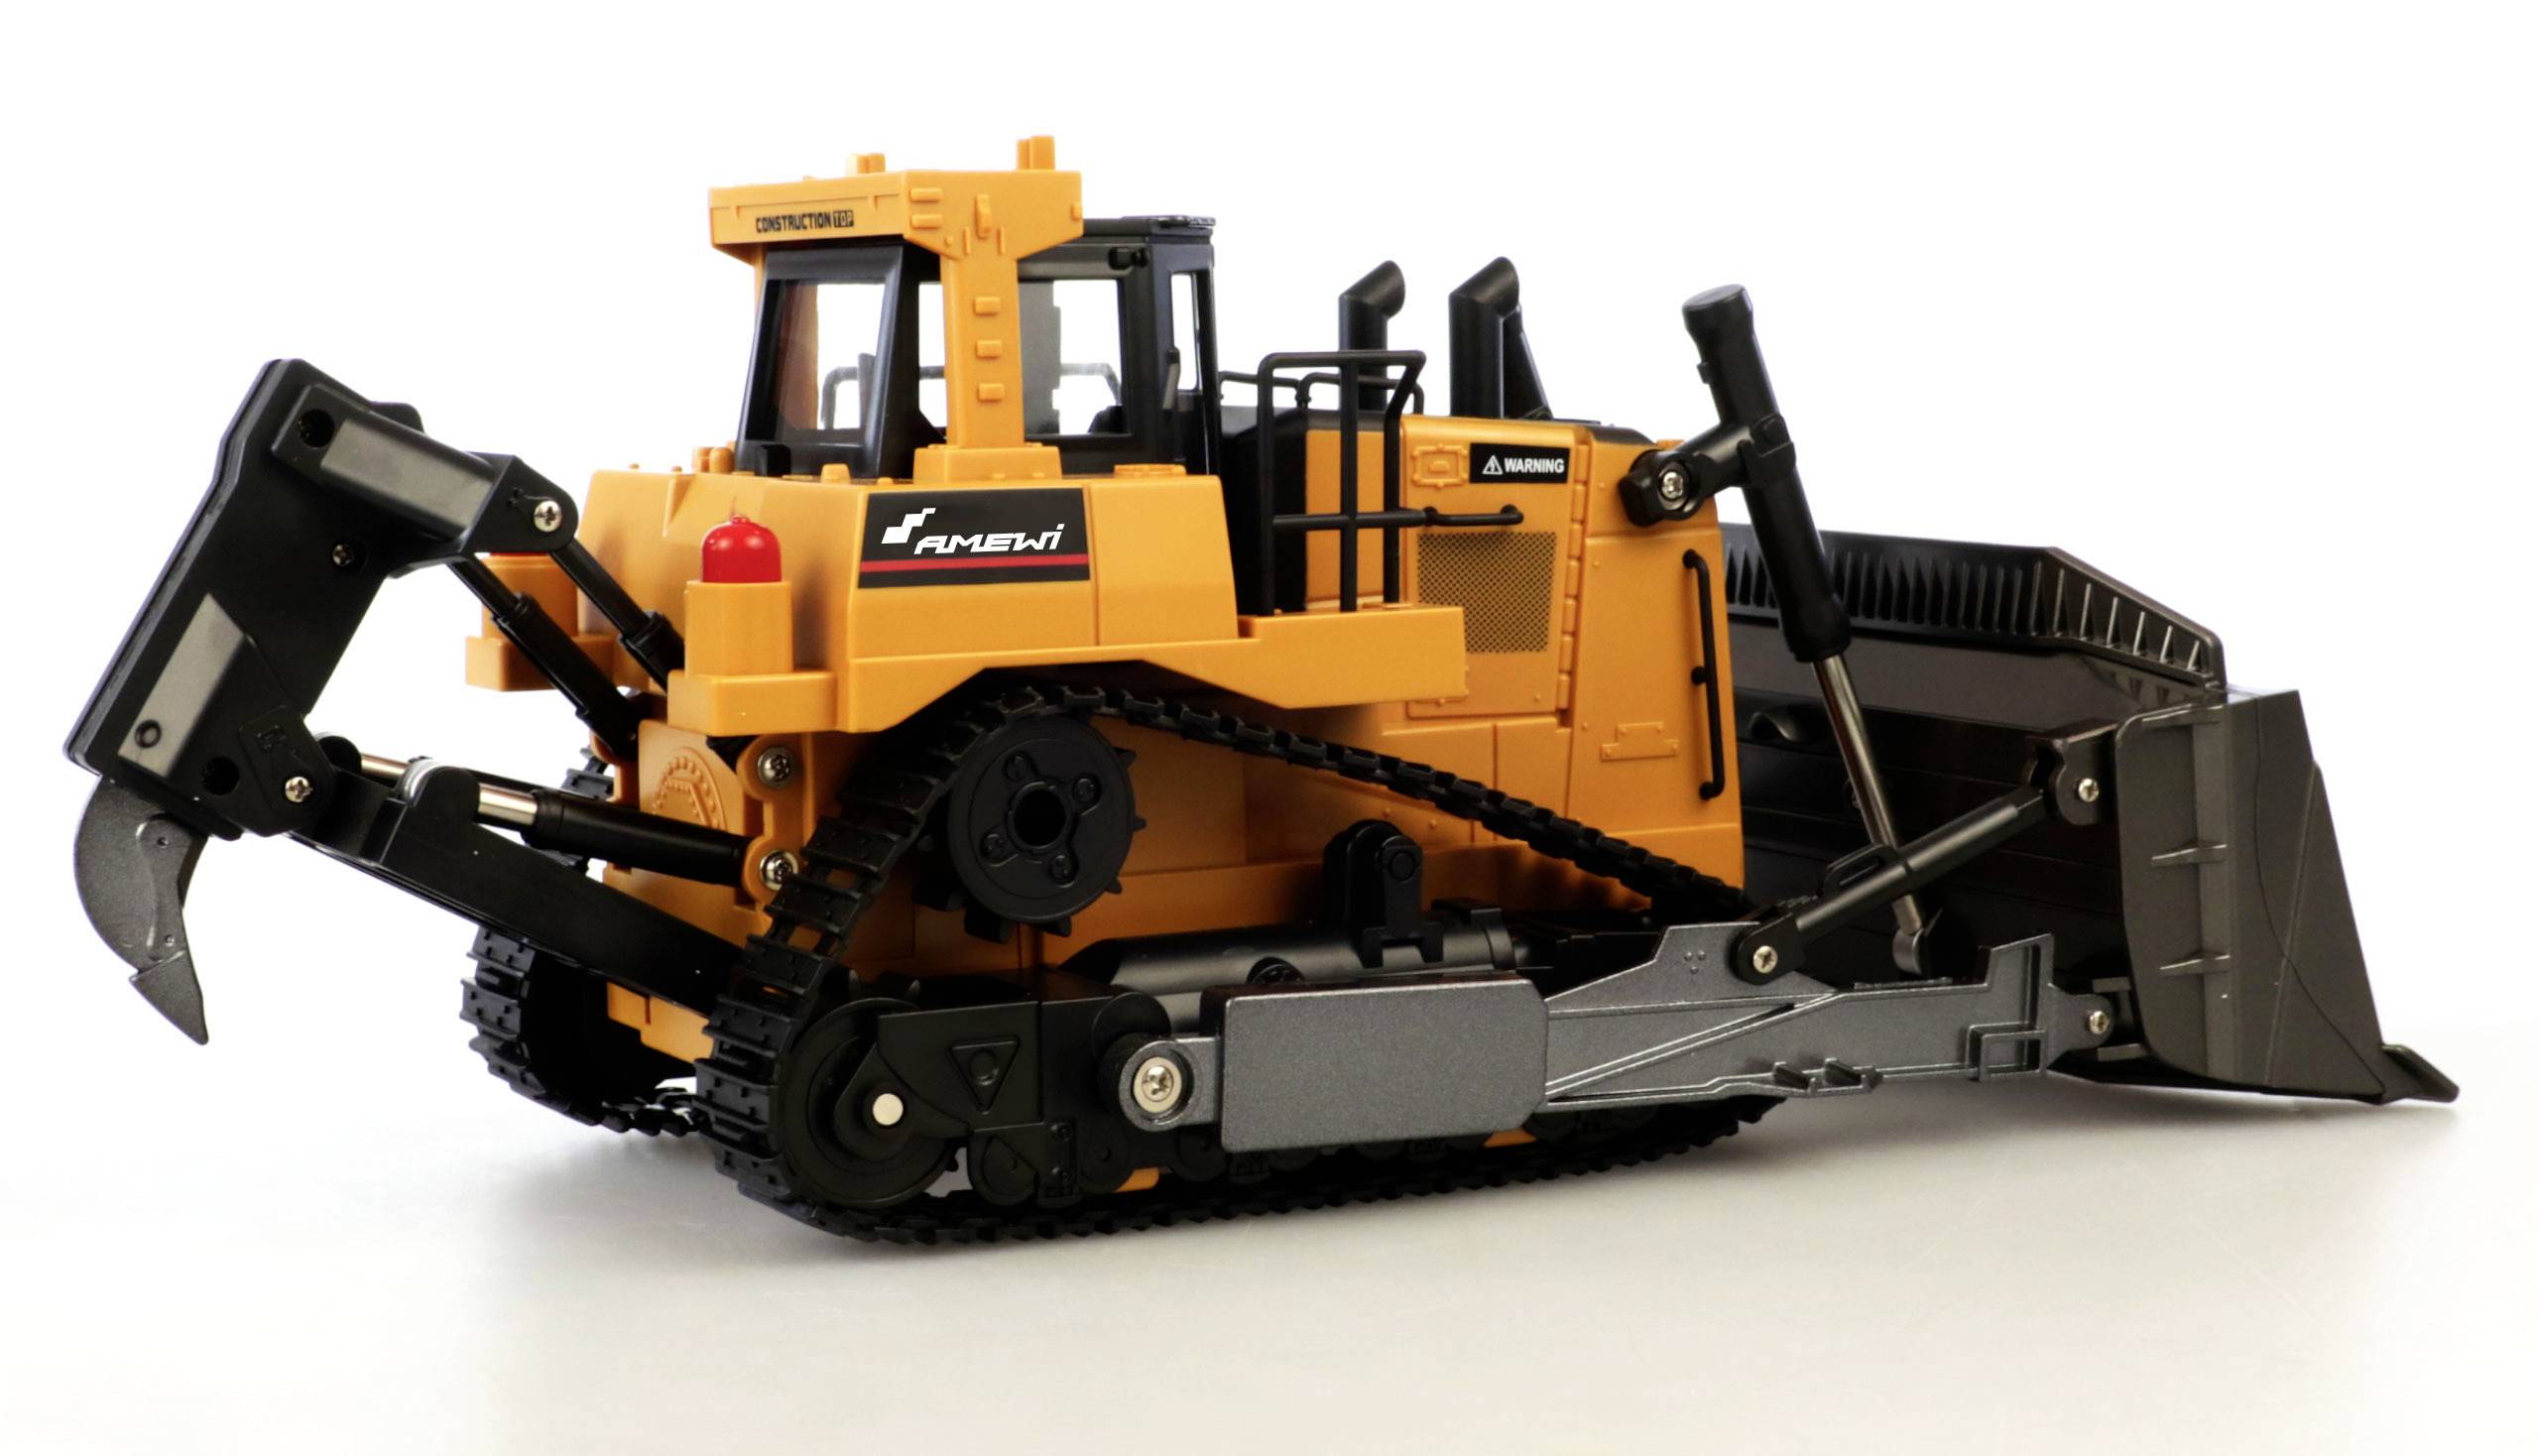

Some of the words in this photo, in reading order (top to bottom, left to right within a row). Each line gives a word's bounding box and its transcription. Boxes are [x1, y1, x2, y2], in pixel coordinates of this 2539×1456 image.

[756, 211, 831, 233] CONSTRUCTION
[833, 210, 853, 227] TOP
[1504, 457, 1565, 474] WARNING
